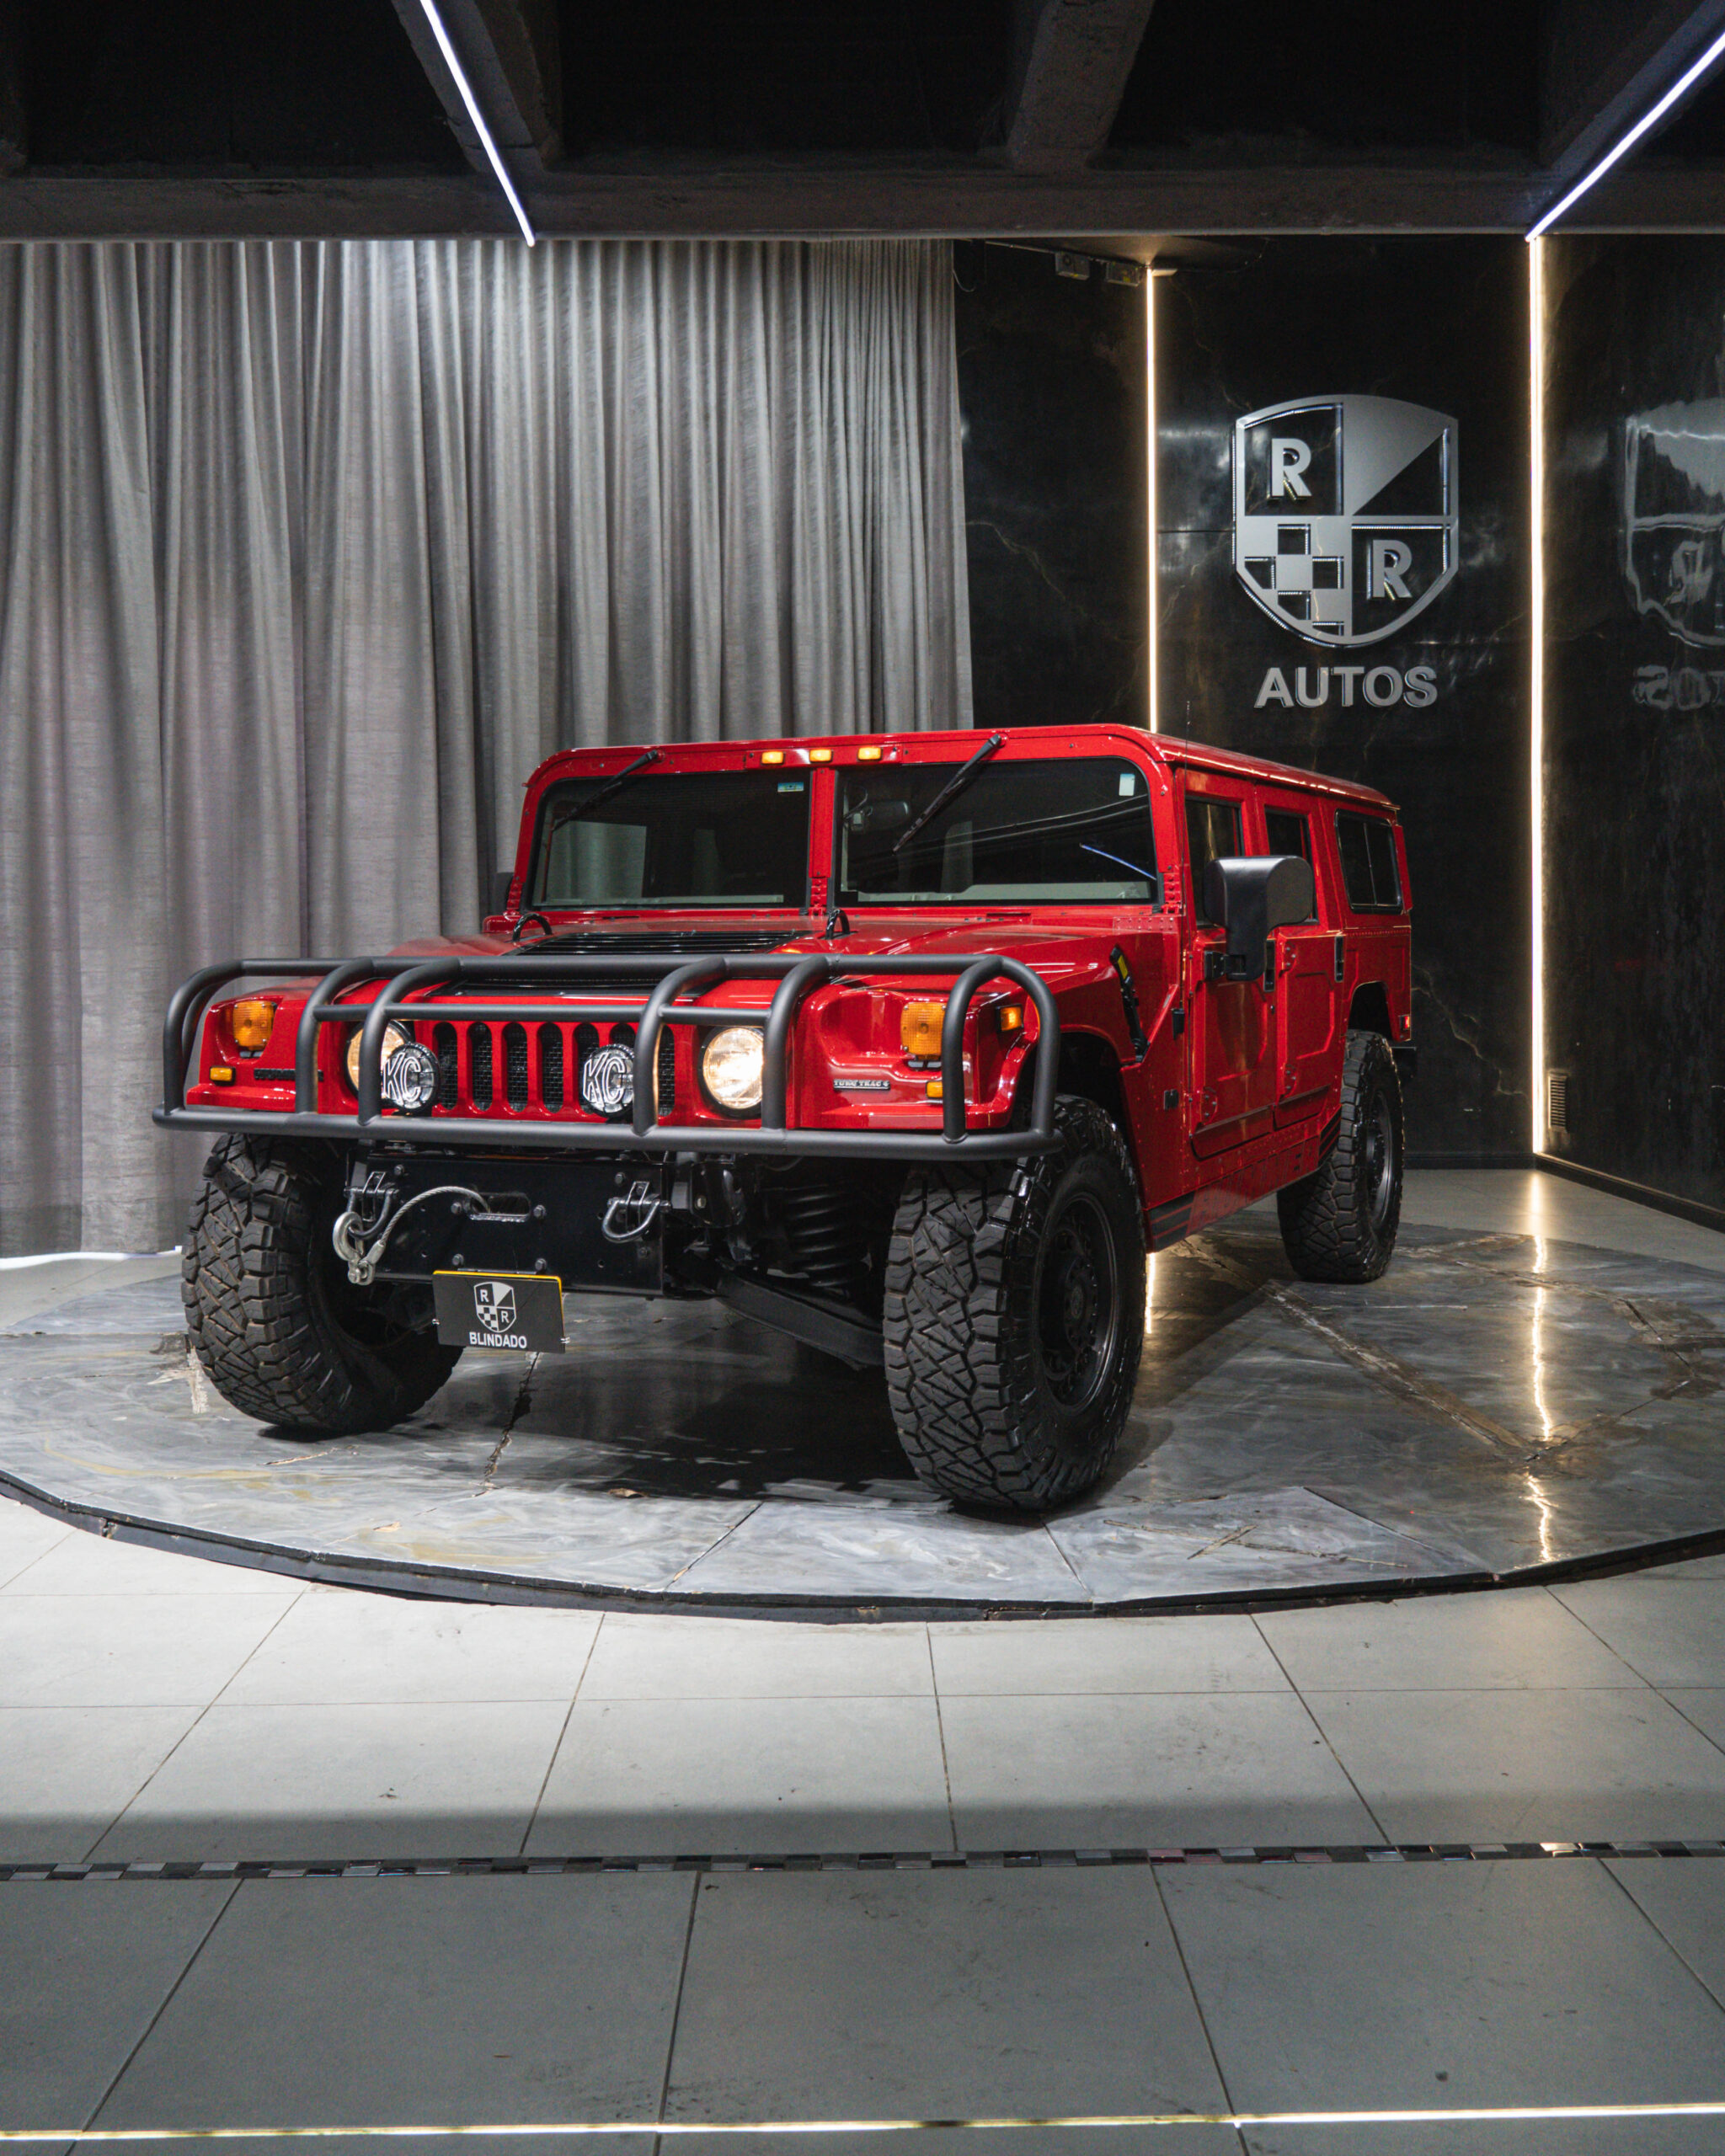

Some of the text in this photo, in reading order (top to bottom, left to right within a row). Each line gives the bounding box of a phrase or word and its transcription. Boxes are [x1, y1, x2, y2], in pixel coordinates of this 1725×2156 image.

[1269, 438, 1312, 499] R
[1370, 539, 1413, 600] R
[1254, 665, 1438, 708] AUTOS
[382, 1052, 421, 1105] KC
[582, 1052, 626, 1105] KC
[479, 1289, 489, 1302] R
[500, 1310, 509, 1323] R
[469, 1331, 527, 1348] BLINDADO
